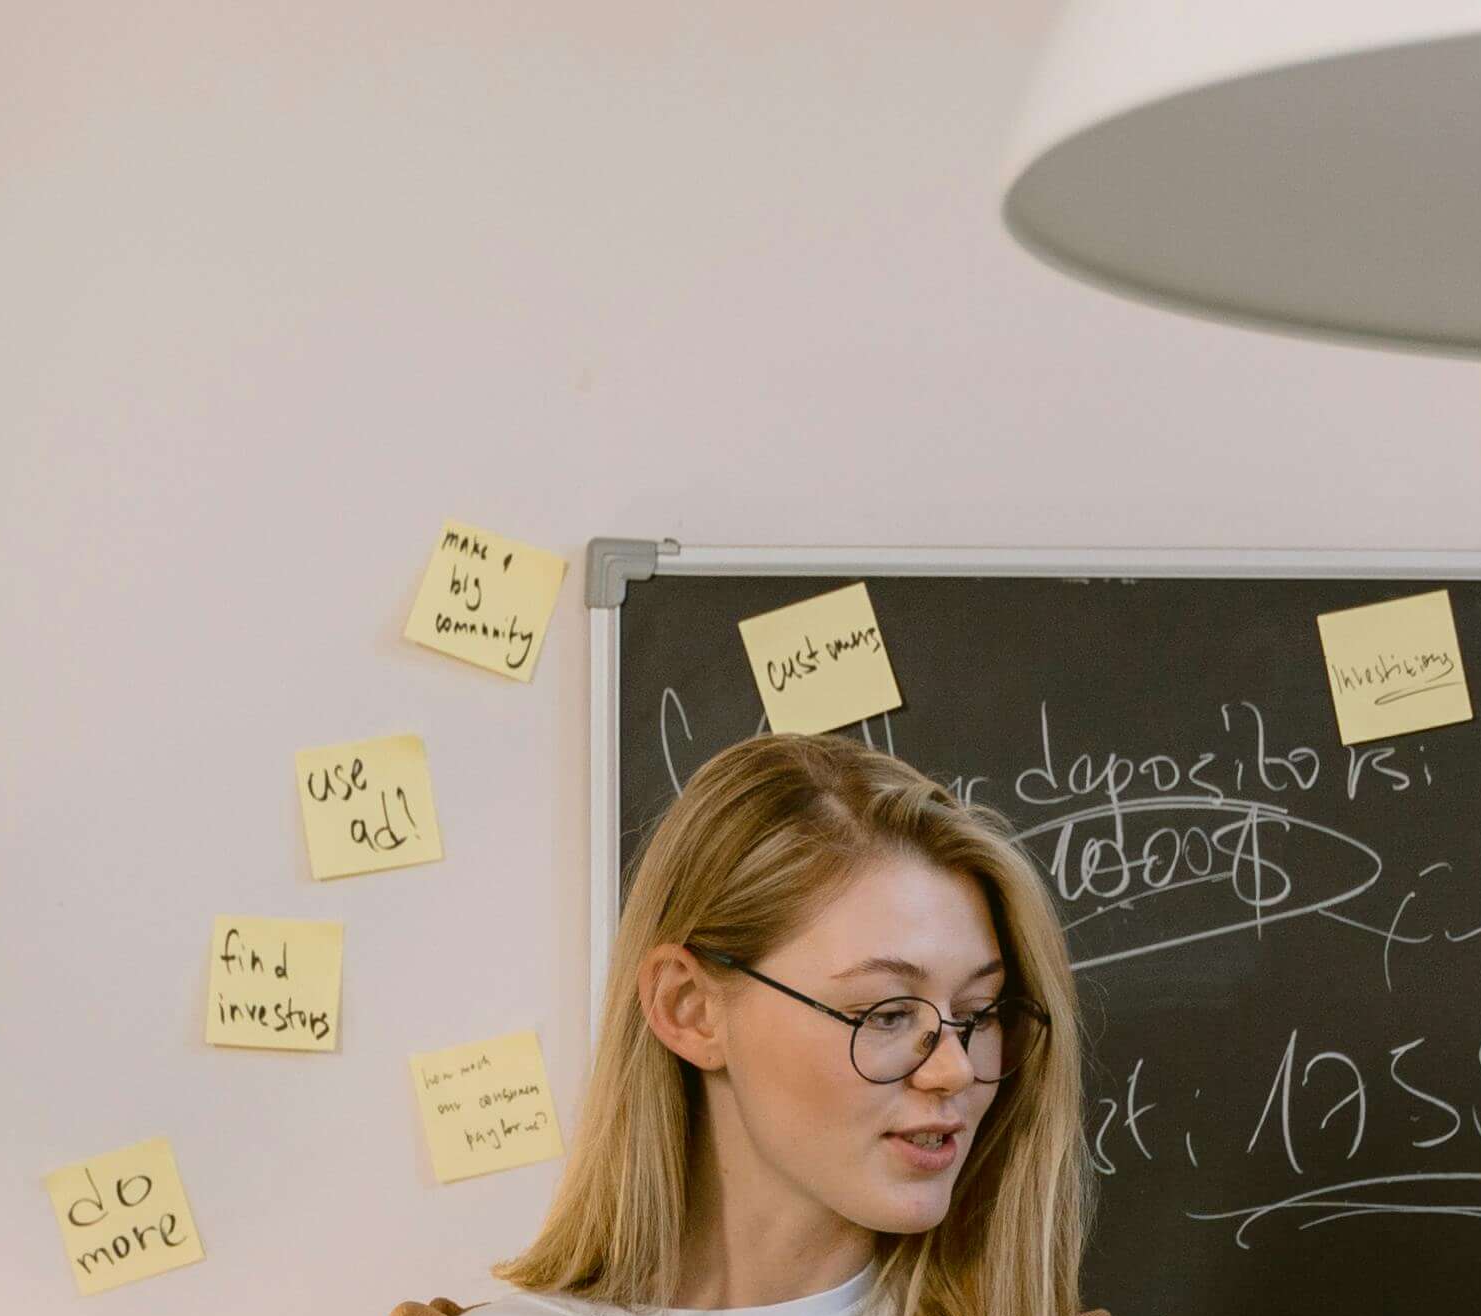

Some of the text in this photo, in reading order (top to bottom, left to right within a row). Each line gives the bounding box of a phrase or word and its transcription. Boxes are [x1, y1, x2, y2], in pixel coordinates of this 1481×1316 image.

[449, 562, 483, 612] big
[307, 757, 367, 802] use
[220, 927, 289, 981] find
[217, 990, 331, 1041] investors
[67, 1166, 153, 1228] do
[76, 1212, 189, 1275] more
